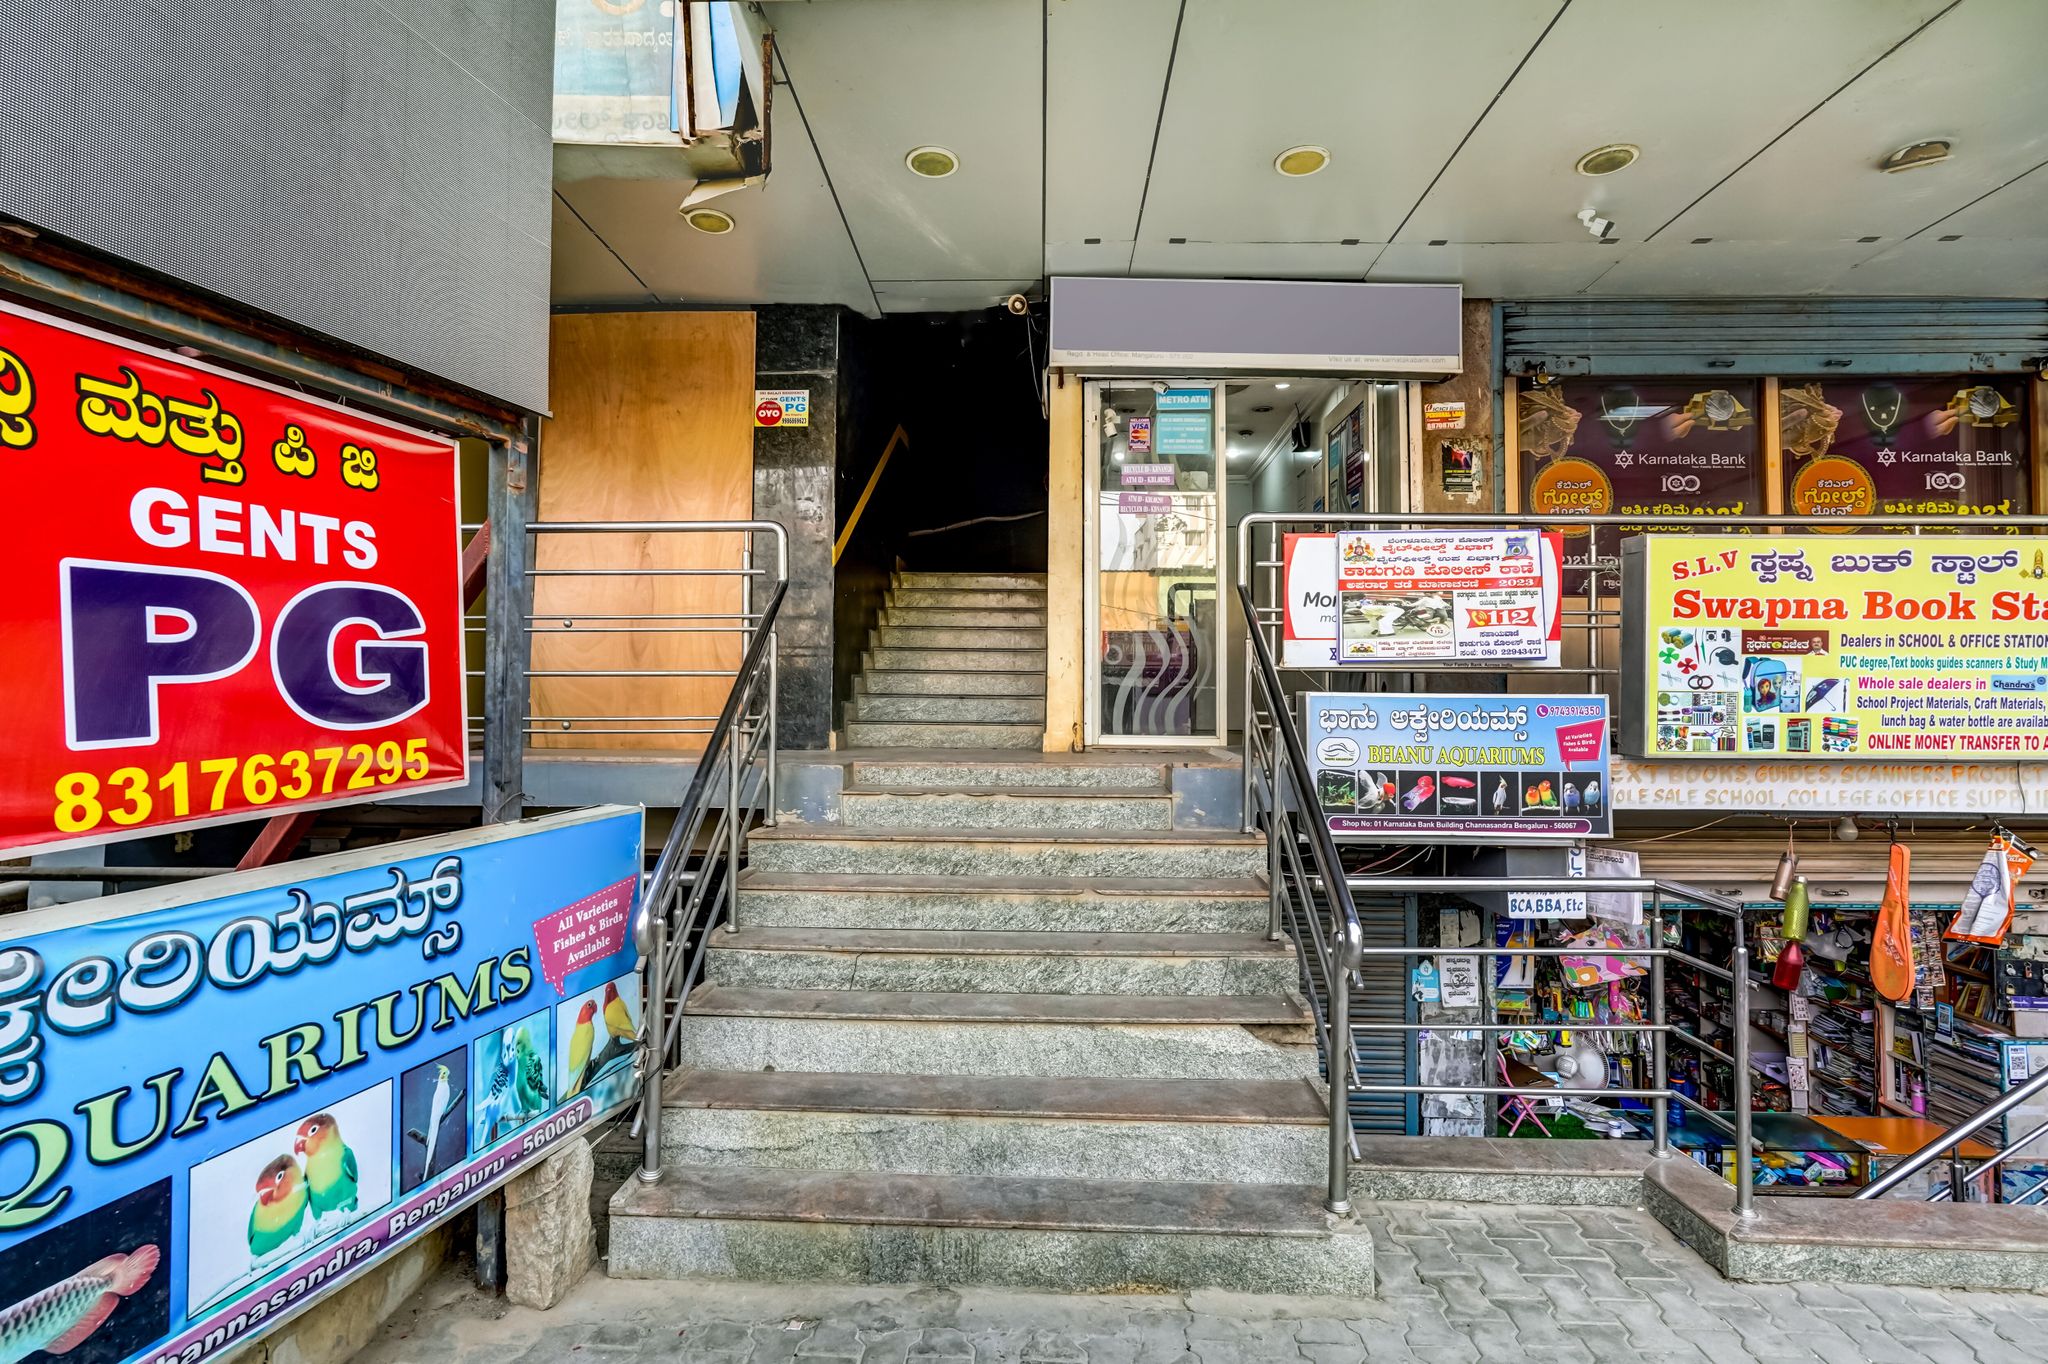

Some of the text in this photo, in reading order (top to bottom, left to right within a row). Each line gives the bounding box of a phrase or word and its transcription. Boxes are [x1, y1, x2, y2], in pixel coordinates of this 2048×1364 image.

[1160, 395, 1208, 404] METRO ATM
[785, 404, 806, 412] PG
[76, 366, 246, 485] ಮತ್ತು
[272, 423, 317, 478] ಪಿ
[341, 443, 379, 491] ಜಿ
[1639, 453, 1746, 466] Karnataka Bank
[1902, 450, 2012, 463] Karnataka Bank
[129, 487, 378, 570] GENTS
[1344, 565, 1415, 577] ಕಾಡುಗುಡಿ
[1499, 562, 1534, 574] ಠಾಣೆ
[1672, 550, 1738, 580] S.L.V
[1751, 549, 2018, 584] ಸ್ವಪ್ನ ಬುಕ್ ಸ್ಟಾಲ್
[1346, 581, 1389, 589] ಅಪರಾಧ
[1499, 579, 1534, 587] 2023
[1673, 590, 1848, 627] Swapna
[1862, 592, 1976, 620] Book
[1488, 610, 1530, 625] 112
[1841, 634, 1882, 648] Dealers
[1885, 634, 1895, 647] in
[1899, 634, 1944, 647] SCHOOL
[1949, 635, 1956, 647] &
[1960, 635, 2000, 647] OFFICE
[59, 557, 430, 751] PG
[1840, 656, 1857, 668] PUC
[1910, 656, 1934, 669] books
[1937, 657, 1964, 671] guides
[1966, 657, 2003, 669] scanners
[2006, 658, 2012, 669] &
[2015, 657, 2038, 672] Study
[1858, 677, 1895, 689] Whole
[1899, 677, 1924, 689] sale
[1927, 677, 1972, 690] dealers
[1976, 677, 1986, 690] in
[1550, 705, 1601, 716] 9743914350
[1857, 696, 2047, 711] School Project Materials, Craft Materials,
[1319, 703, 1378, 733] ಭಾನು
[1882, 715, 1906, 727] lunch
[1910, 715, 1925, 729] bag
[1929, 716, 1935, 727] &
[1939, 716, 1965, 728] water
[1968, 715, 1994, 728] bottle
[1998, 718, 2012, 728] are
[1868, 735, 1911, 749] ONLINE
[1915, 735, 1956, 750] MONEY
[1960, 735, 2020, 750] TRANSFER
[2025, 735, 2039, 750] TO
[1368, 745, 1545, 767] BHANU AQUARIUMS
[53, 738, 430, 833] 8317637295
[1653, 789, 1698, 805] SALE
[1342, 820, 1359, 829] Shop
[1361, 820, 1372, 828] No:
[1436, 821, 1464, 830] Building
[1514, 822, 1549, 831] Bengaluru
[558, 898, 618, 932] All Varieties
[553, 912, 623, 954] Fishes & Birds
[567, 936, 611, 965] Available
[388, 1155, 506, 1240] Bengaluru
[522, 1103, 587, 1156] 560067
